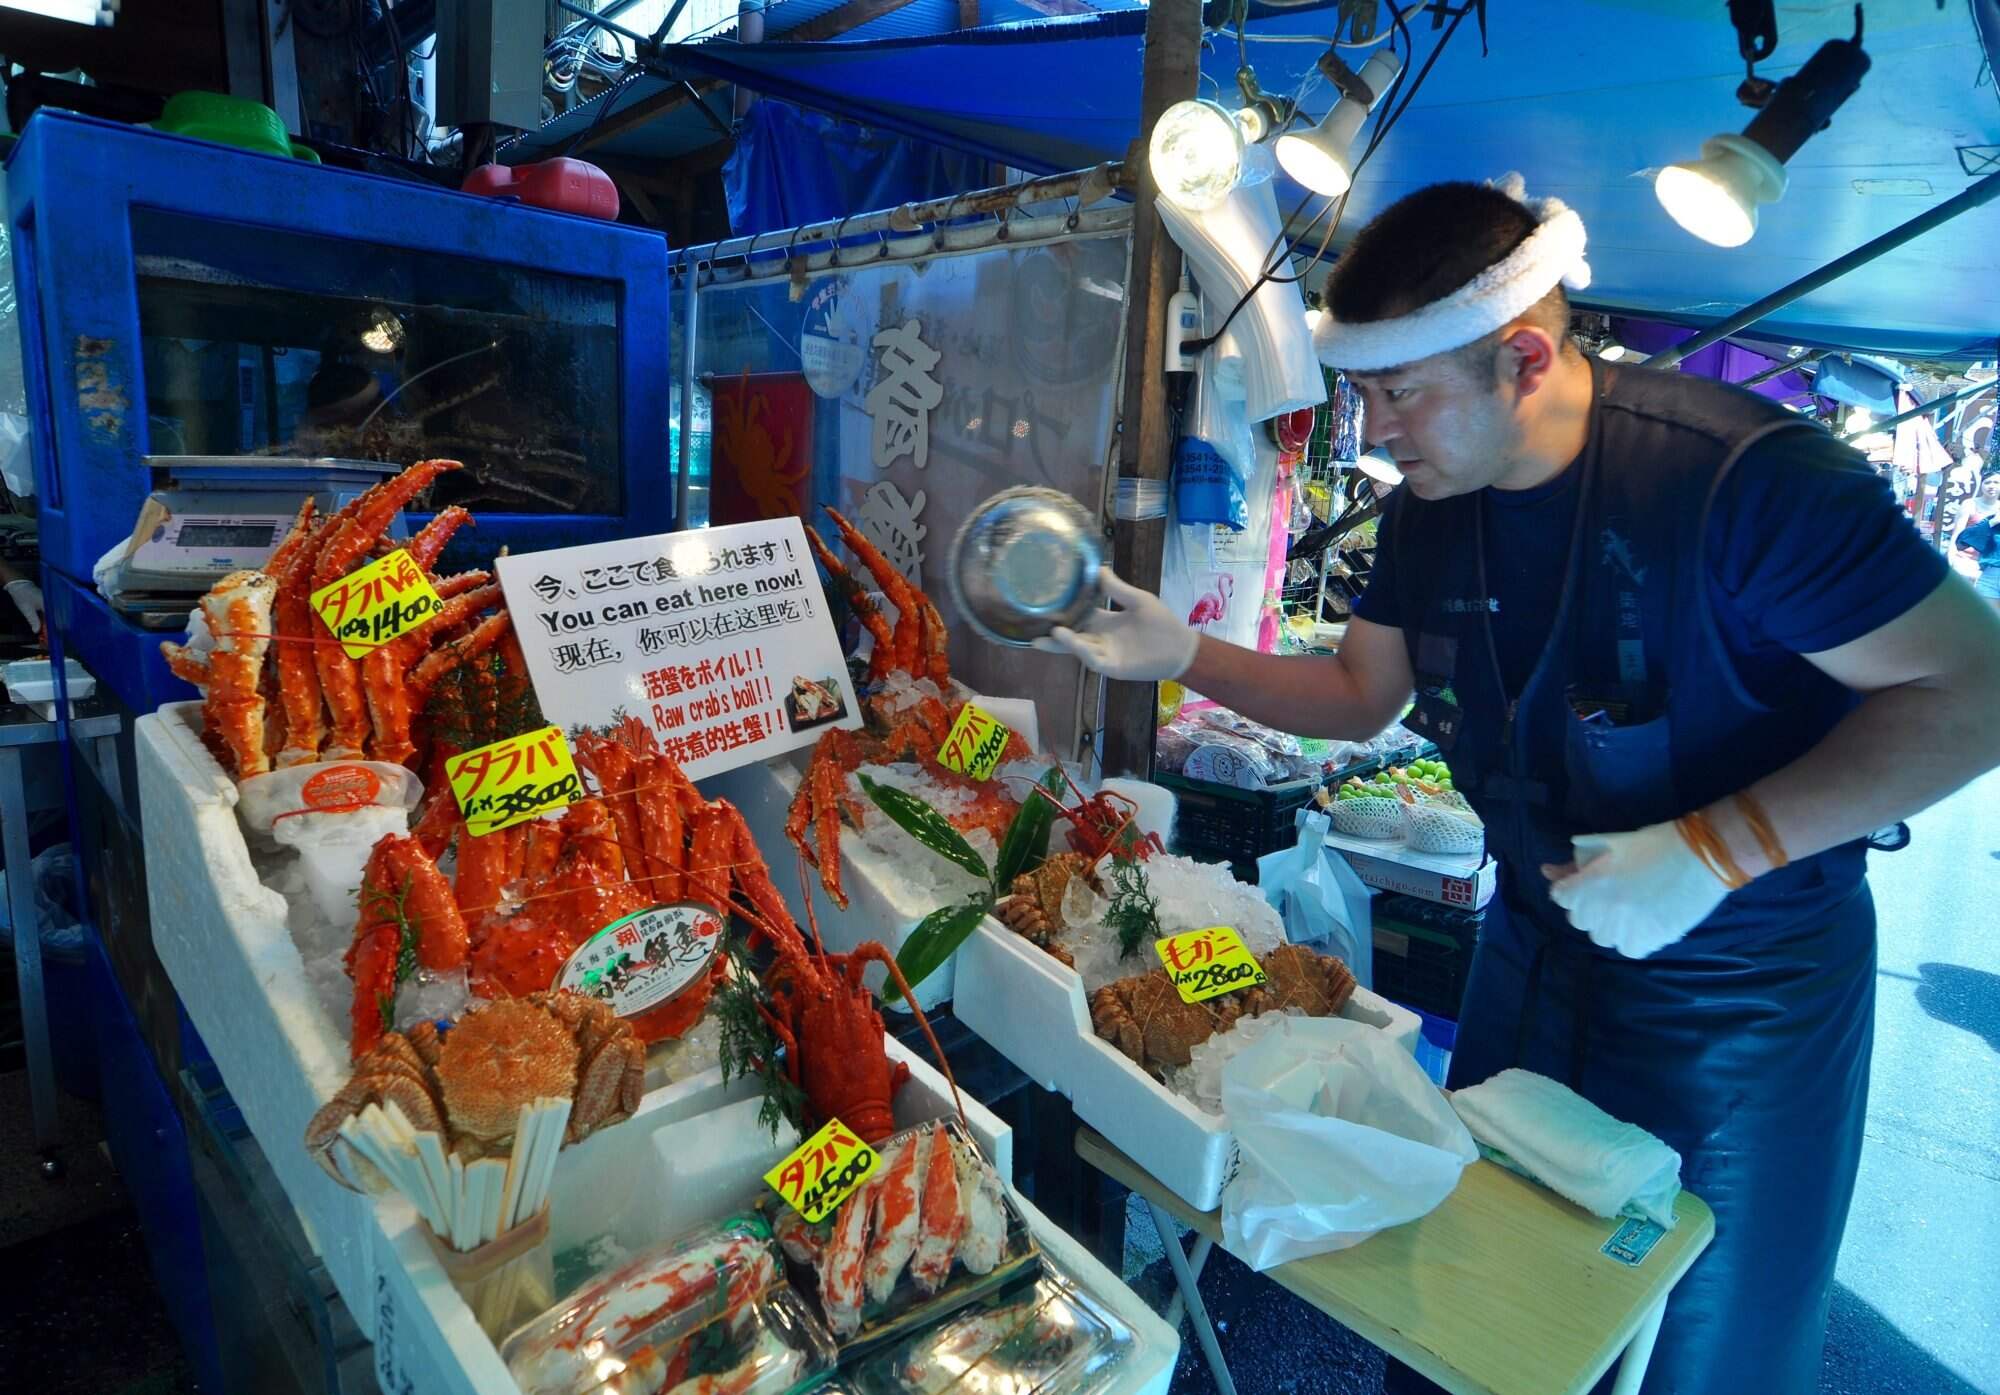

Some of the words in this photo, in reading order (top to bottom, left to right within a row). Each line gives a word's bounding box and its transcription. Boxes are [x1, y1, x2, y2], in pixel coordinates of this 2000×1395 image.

[535, 539, 794, 599] 今、ここで食られます！
[541, 610, 594, 632] You
[603, 600, 648, 622] can
[655, 588, 694, 612] eat
[699, 583, 748, 604] here
[755, 569, 803, 593] now!
[652, 703, 685, 732] Raw
[690, 688, 730, 722] crab's
[946, 705, 988, 773] タラバ
[452, 728, 562, 800] タラバ
[779, 1120, 857, 1203] タラバ
